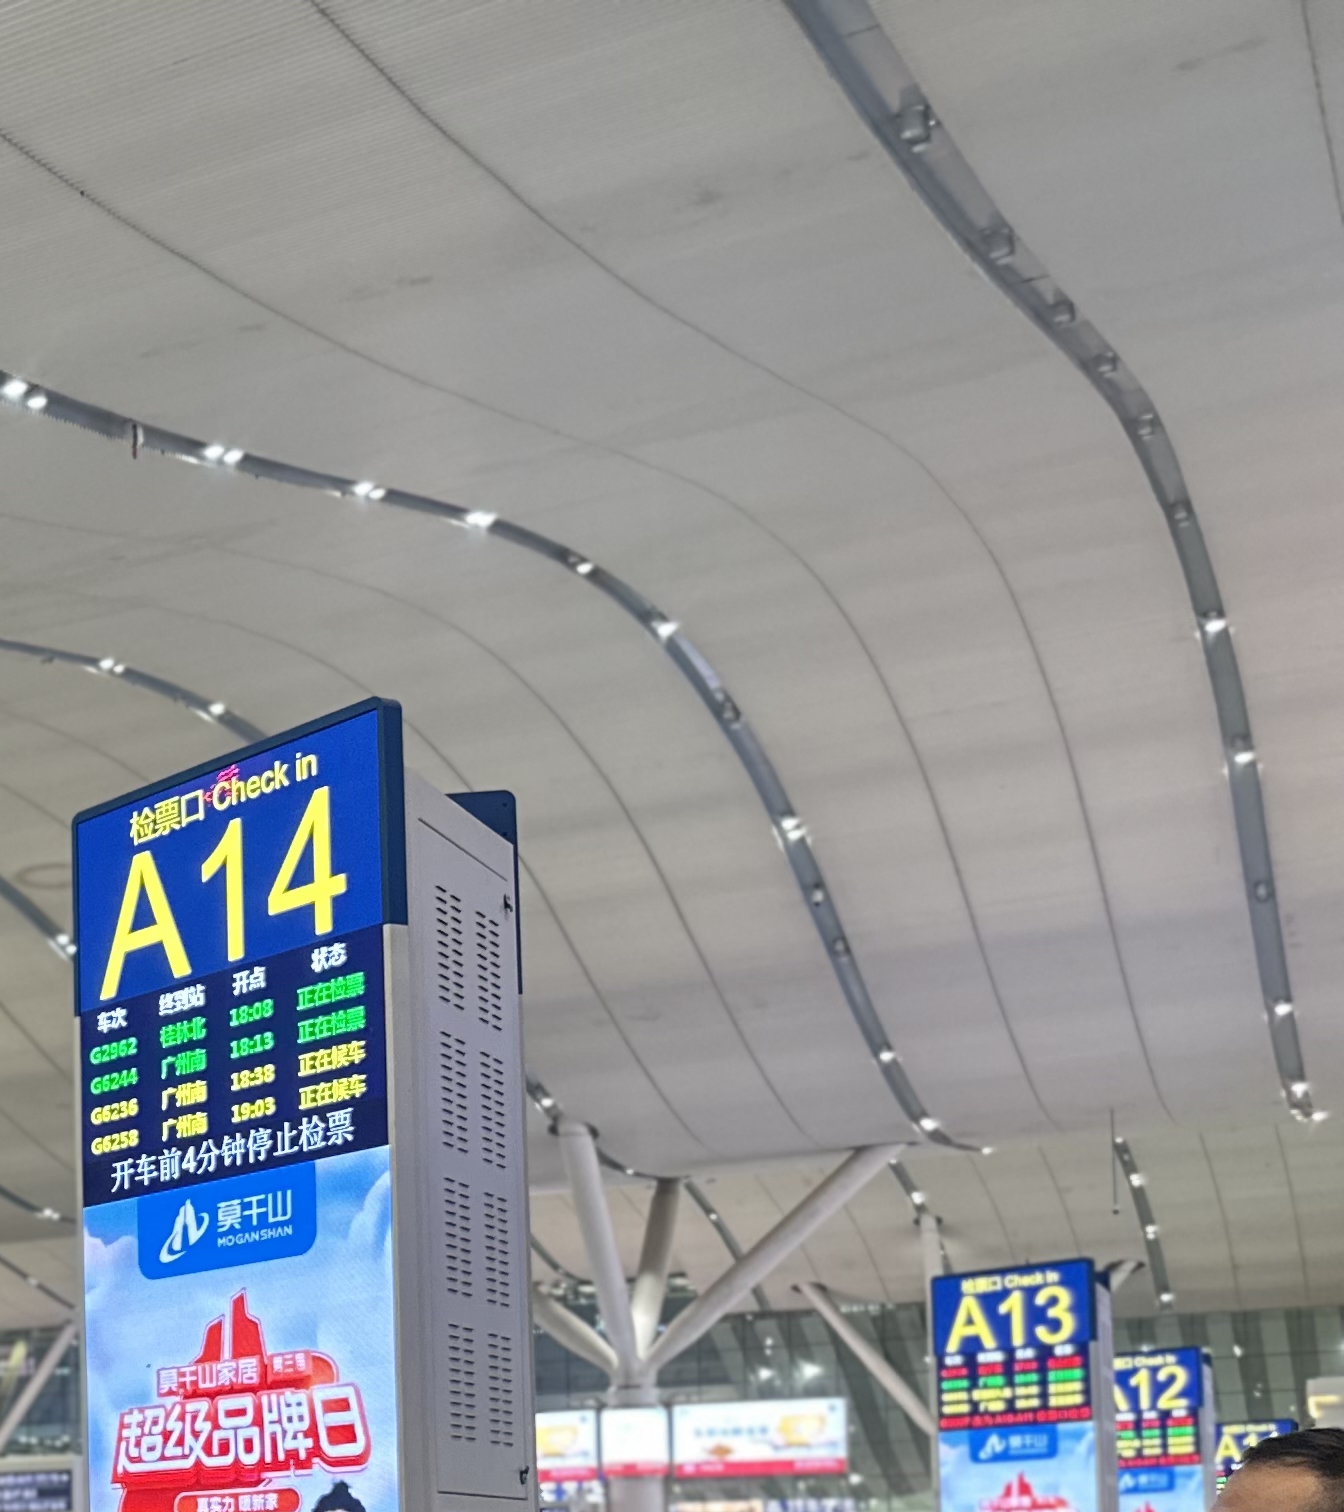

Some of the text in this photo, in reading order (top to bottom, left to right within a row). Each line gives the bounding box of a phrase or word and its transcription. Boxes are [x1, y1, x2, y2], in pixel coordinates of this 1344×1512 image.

[130, 751, 318, 846] 检票口 Check in
[99, 785, 348, 1000] A14
[97, 943, 347, 1034] 车次 终到站 开点 状态
[160, 1016, 207, 1048] 桂林北
[229, 999, 274, 1027] 18:08
[297, 972, 365, 1010] 正在检票
[90, 1005, 366, 1095] G6244 广州南 18:13 正在检票
[161, 1080, 208, 1111] 广州南
[230, 1064, 275, 1091] 18:38
[298, 1040, 366, 1077] 正在候车
[162, 1112, 208, 1142] 广州南
[231, 1096, 276, 1124] 19:03
[298, 1074, 367, 1110] 正在候车
[110, 1107, 355, 1193] 开车前4分钟停止检票
[216, 1189, 293, 1233] 莫干山
[217, 1225, 293, 1248] MOGANSHAN
[945, 1285, 1077, 1353] A13
[158, 1357, 258, 1394] 莫干山家居
[116, 1385, 366, 1476] 超级品牌日
